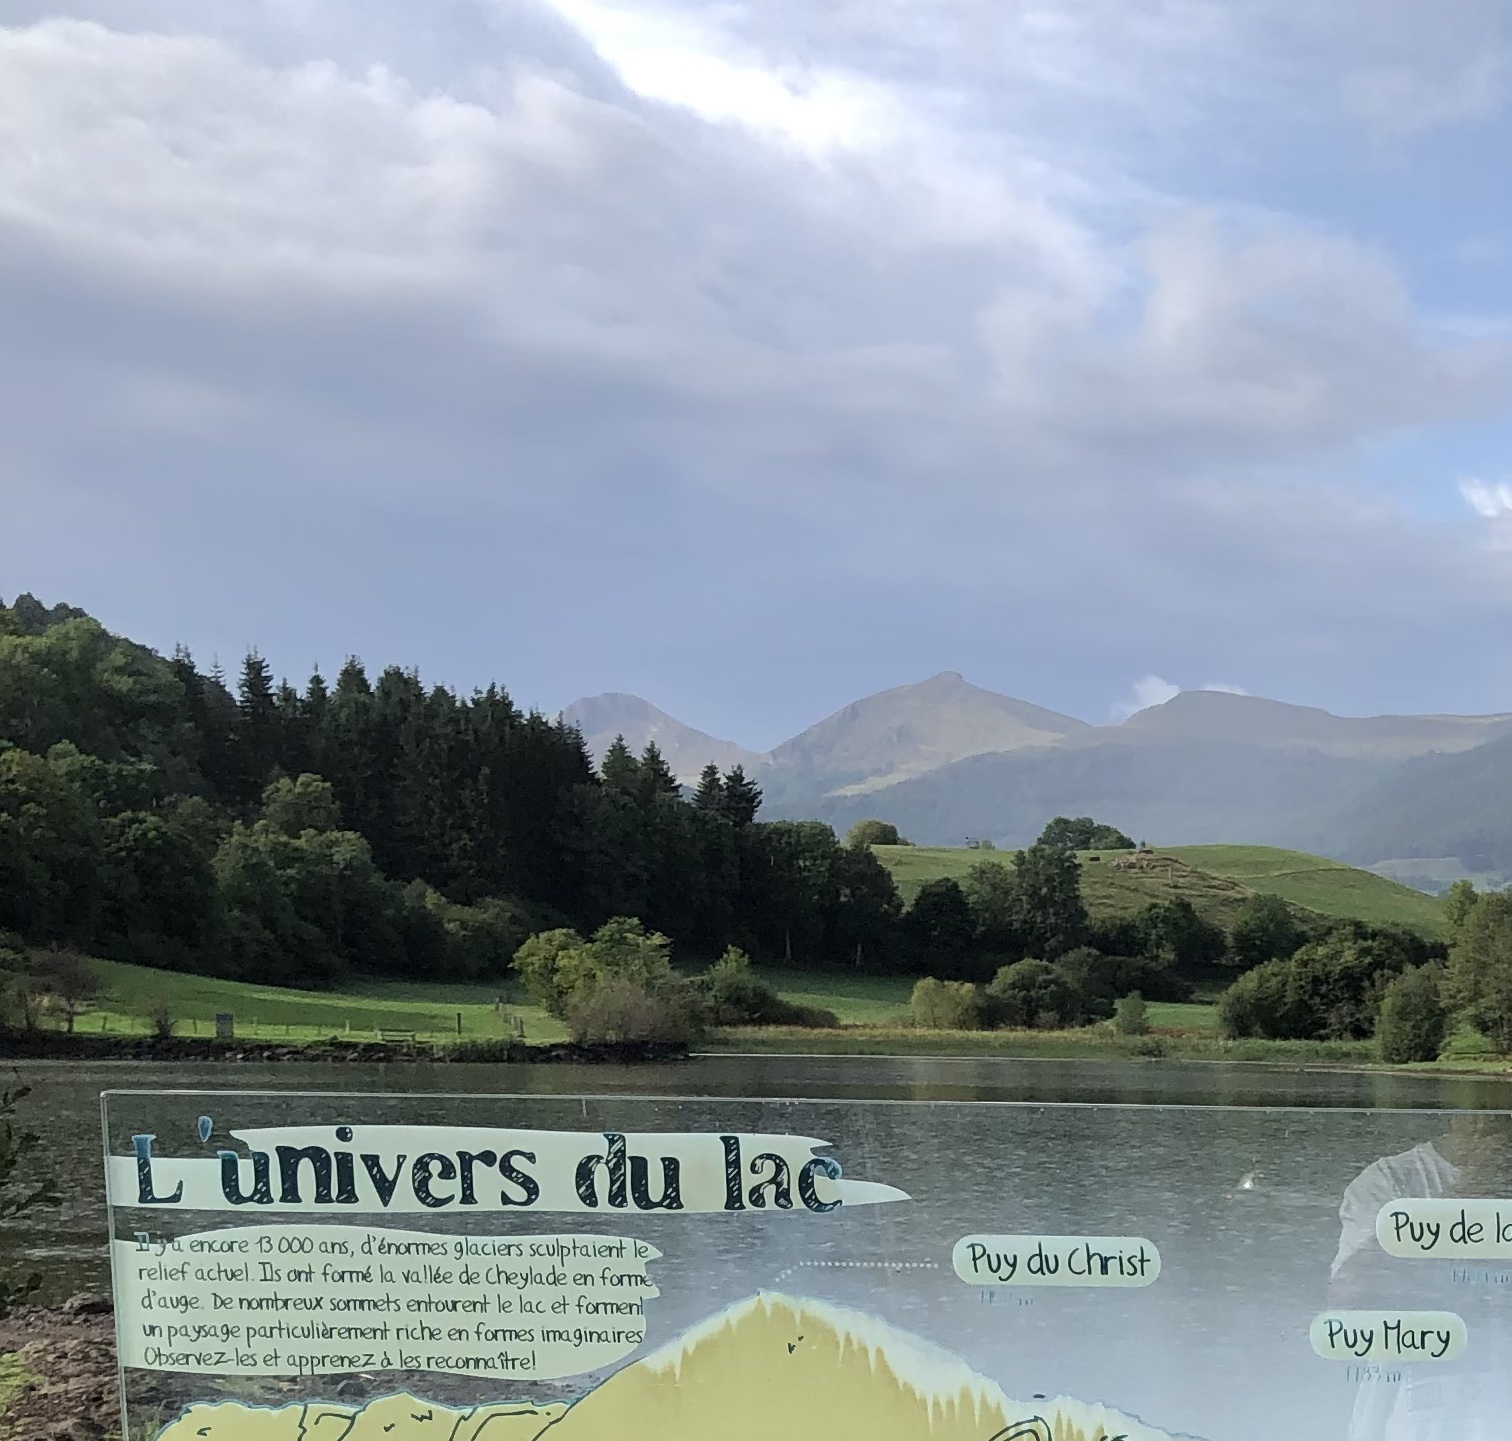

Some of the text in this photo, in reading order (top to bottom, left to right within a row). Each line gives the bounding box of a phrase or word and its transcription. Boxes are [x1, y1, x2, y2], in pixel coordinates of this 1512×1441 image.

[132, 1116, 843, 1213] L'univers du lac
[1389, 1211, 1441, 1250] Puy
[1449, 1209, 1484, 1244] de
[172, 1240, 184, 1253] a
[190, 1238, 249, 1253] encore
[255, 1236, 273, 1253] 13
[278, 1237, 314, 1254] 000
[319, 1240, 354, 1257] ans,
[361, 1234, 448, 1255] d'énormes
[454, 1238, 524, 1260] glaciers
[529, 1238, 626, 1267] sculptaient
[634, 1239, 649, 1258] le
[966, 1241, 1151, 1282] Puy du Christ
[138, 1261, 653, 1289] relief actuel. Ils ont formé la vallée de Cheylade en forme
[141, 1288, 204, 1314] d'auge.
[211, 1292, 234, 1310] De
[239, 1291, 323, 1311] nombreux
[330, 1293, 401, 1312] sommets
[407, 1294, 490, 1313] entourent
[498, 1294, 513, 1314] le
[520, 1294, 546, 1314] lac
[552, 1296, 569, 1314] et
[143, 1323, 162, 1338] un
[168, 1323, 240, 1347] paysage
[247, 1320, 391, 1348] particulièrement
[397, 1320, 441, 1341] riche
[448, 1328, 469, 1341] en
[475, 1322, 534, 1342] formes
[1323, 1318, 1451, 1358] Puy Mary
[144, 1346, 257, 1367] Observez-les
[263, 1349, 281, 1367] et
[287, 1352, 376, 1374] apprenez
[381, 1351, 393, 1368] à
[400, 1349, 421, 1369] les
